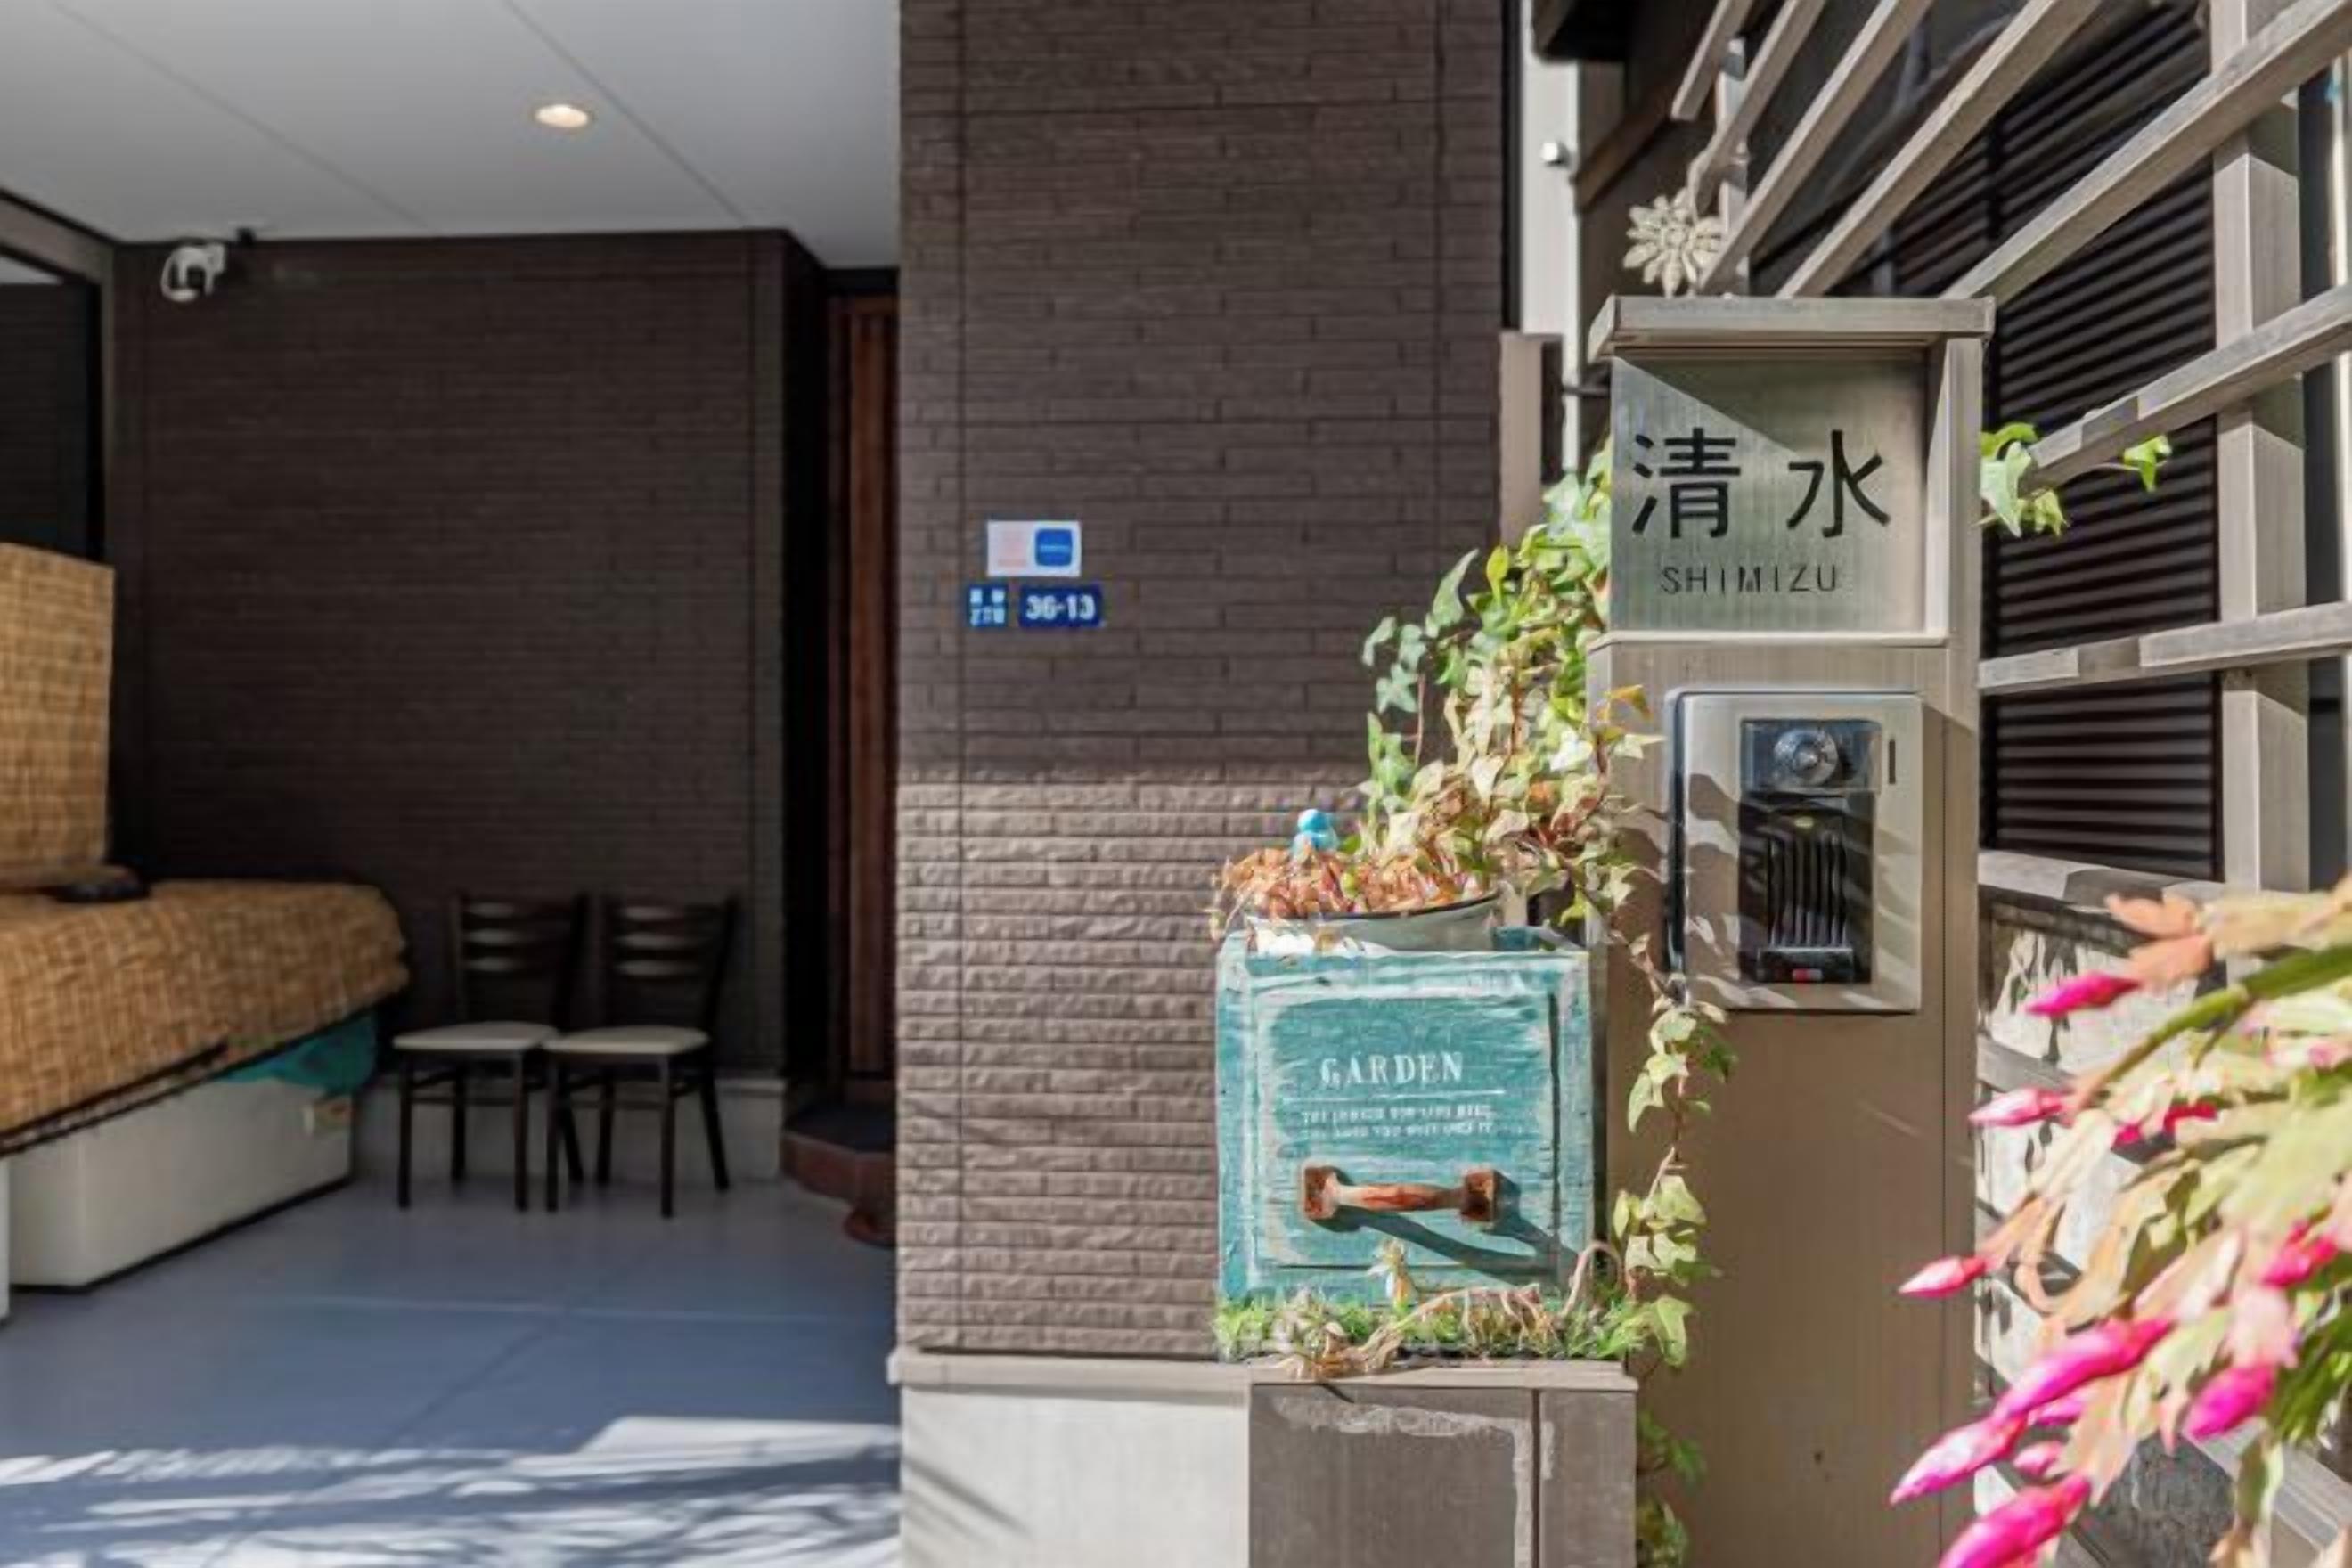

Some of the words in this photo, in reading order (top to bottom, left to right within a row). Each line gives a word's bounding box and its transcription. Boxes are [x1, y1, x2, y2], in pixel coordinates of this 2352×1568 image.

[1631, 427, 1891, 538] 清水
[1661, 564, 1837, 593] SHIMIZU
[1025, 594, 1097, 620] 36-13
[1319, 1050, 1465, 1085] GARDEN
